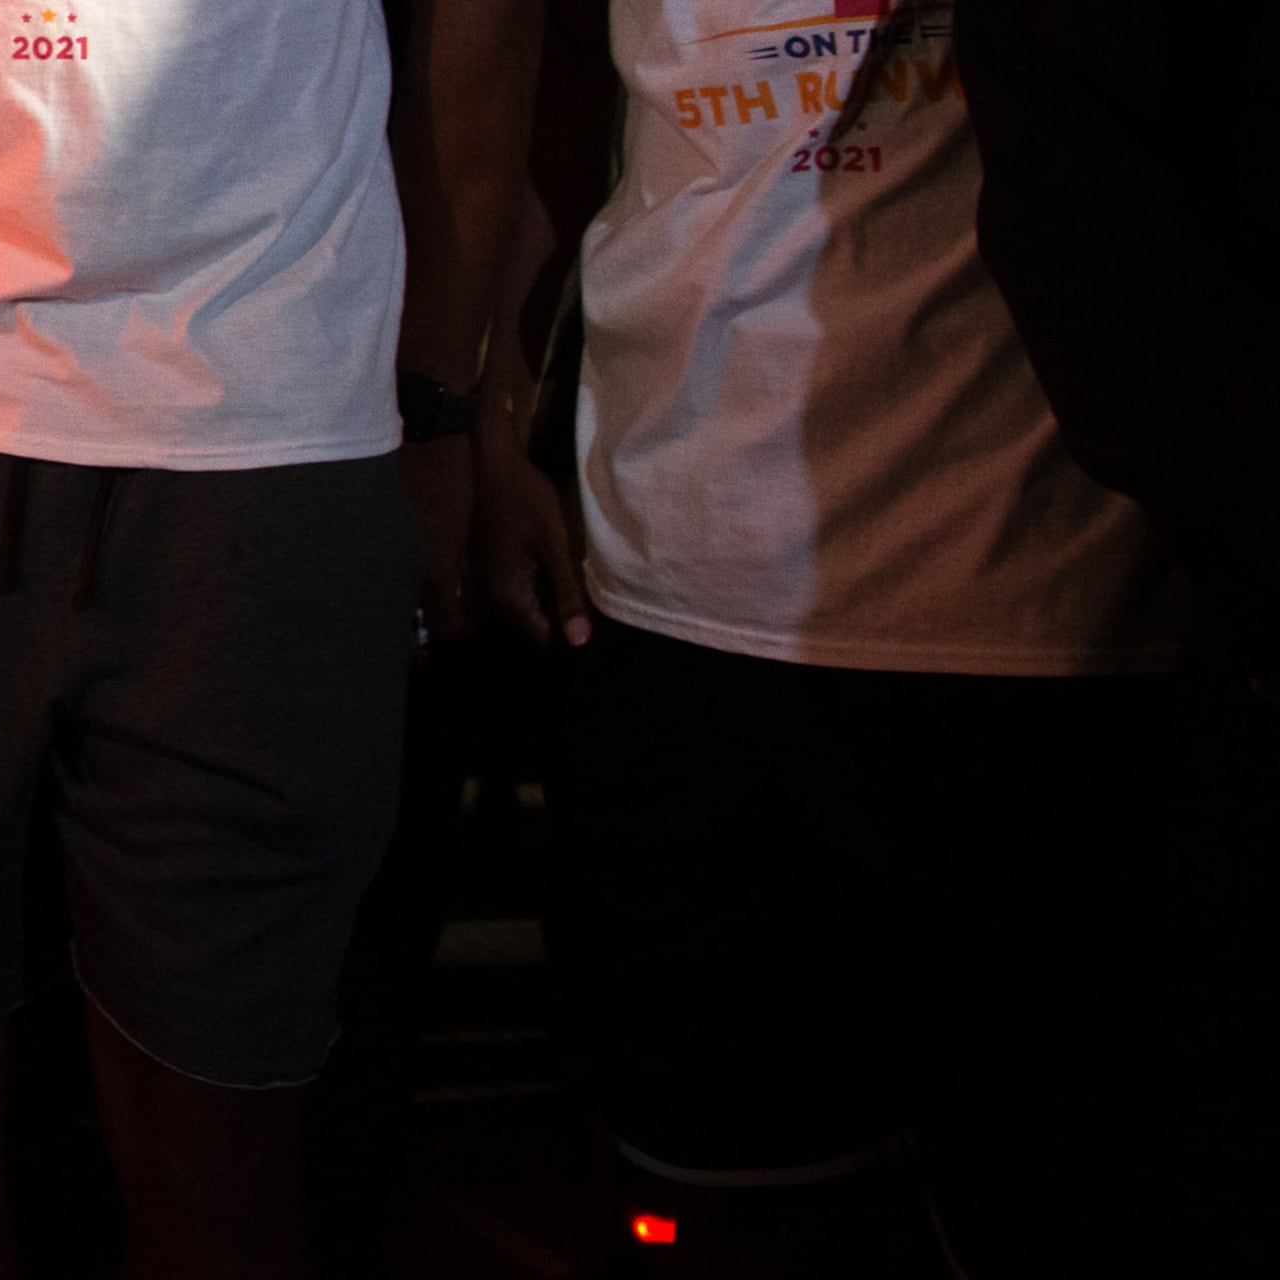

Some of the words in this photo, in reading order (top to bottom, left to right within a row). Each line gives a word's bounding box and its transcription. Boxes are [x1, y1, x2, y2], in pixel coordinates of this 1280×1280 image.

[11, 35, 88, 61] 2021
[785, 32, 837, 58] ON
[675, 81, 778, 128] 5TH
[792, 146, 882, 172] 2021
